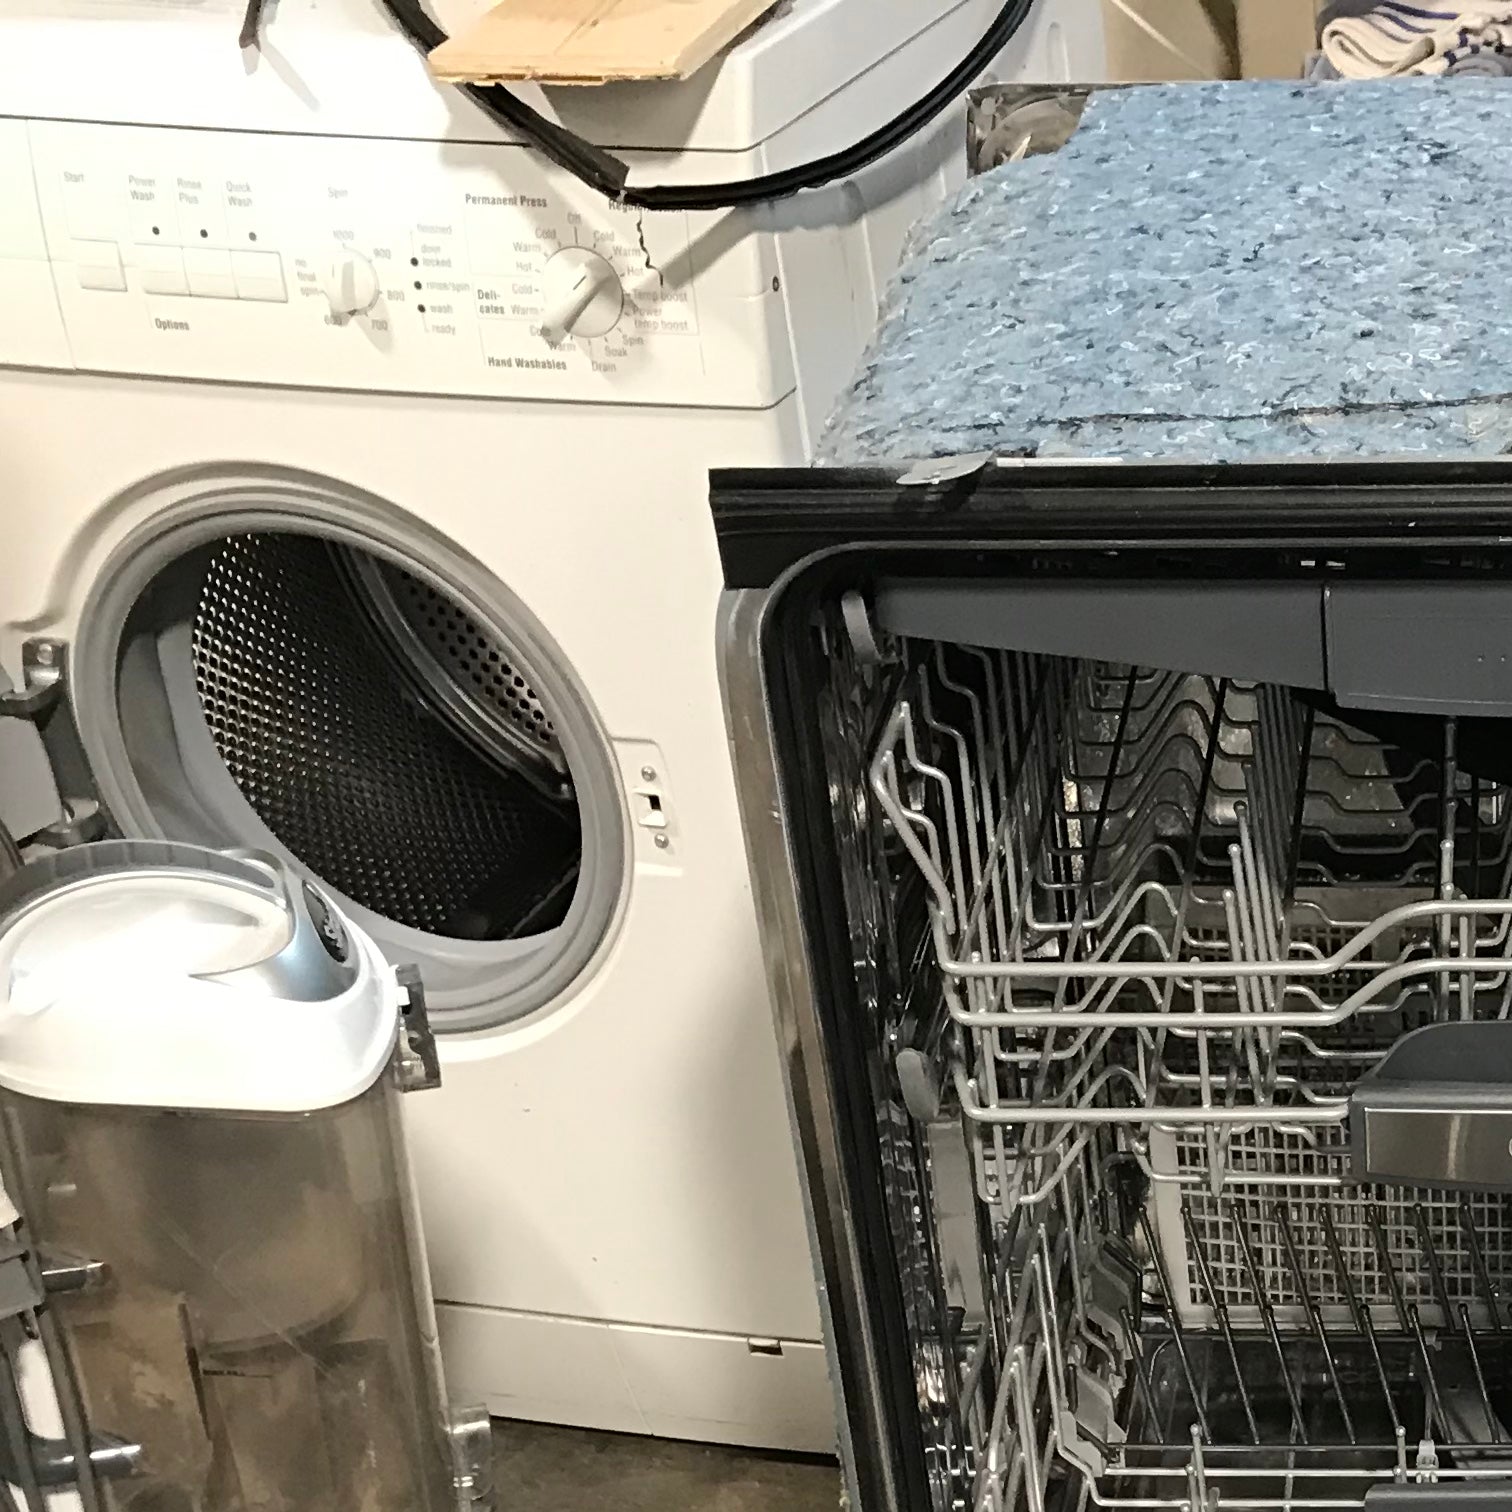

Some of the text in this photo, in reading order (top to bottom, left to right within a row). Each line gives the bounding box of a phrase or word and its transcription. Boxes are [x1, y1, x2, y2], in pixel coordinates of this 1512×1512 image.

[64, 171, 84, 183] Start
[128, 175, 156, 187] Power
[177, 178, 202, 190] Rinse
[226, 181, 251, 192] Quick
[130, 190, 155, 201] Wash
[179, 192, 199, 205] Plus
[228, 195, 253, 207] Wash
[465, 194, 547, 208] Permanent Press
[535, 228, 557, 240] Cold
[593, 231, 615, 243] Cold
[512, 242, 541, 253] Warm
[612, 246, 641, 257] Warm
[516, 262, 532, 272] Hot
[627, 267, 644, 277] Hot
[511, 283, 533, 295] Cold
[430, 304, 453, 313] wash
[155, 318, 190, 331] Options
[488, 356, 567, 371] Hand Washables
[592, 361, 616, 372] Drain
